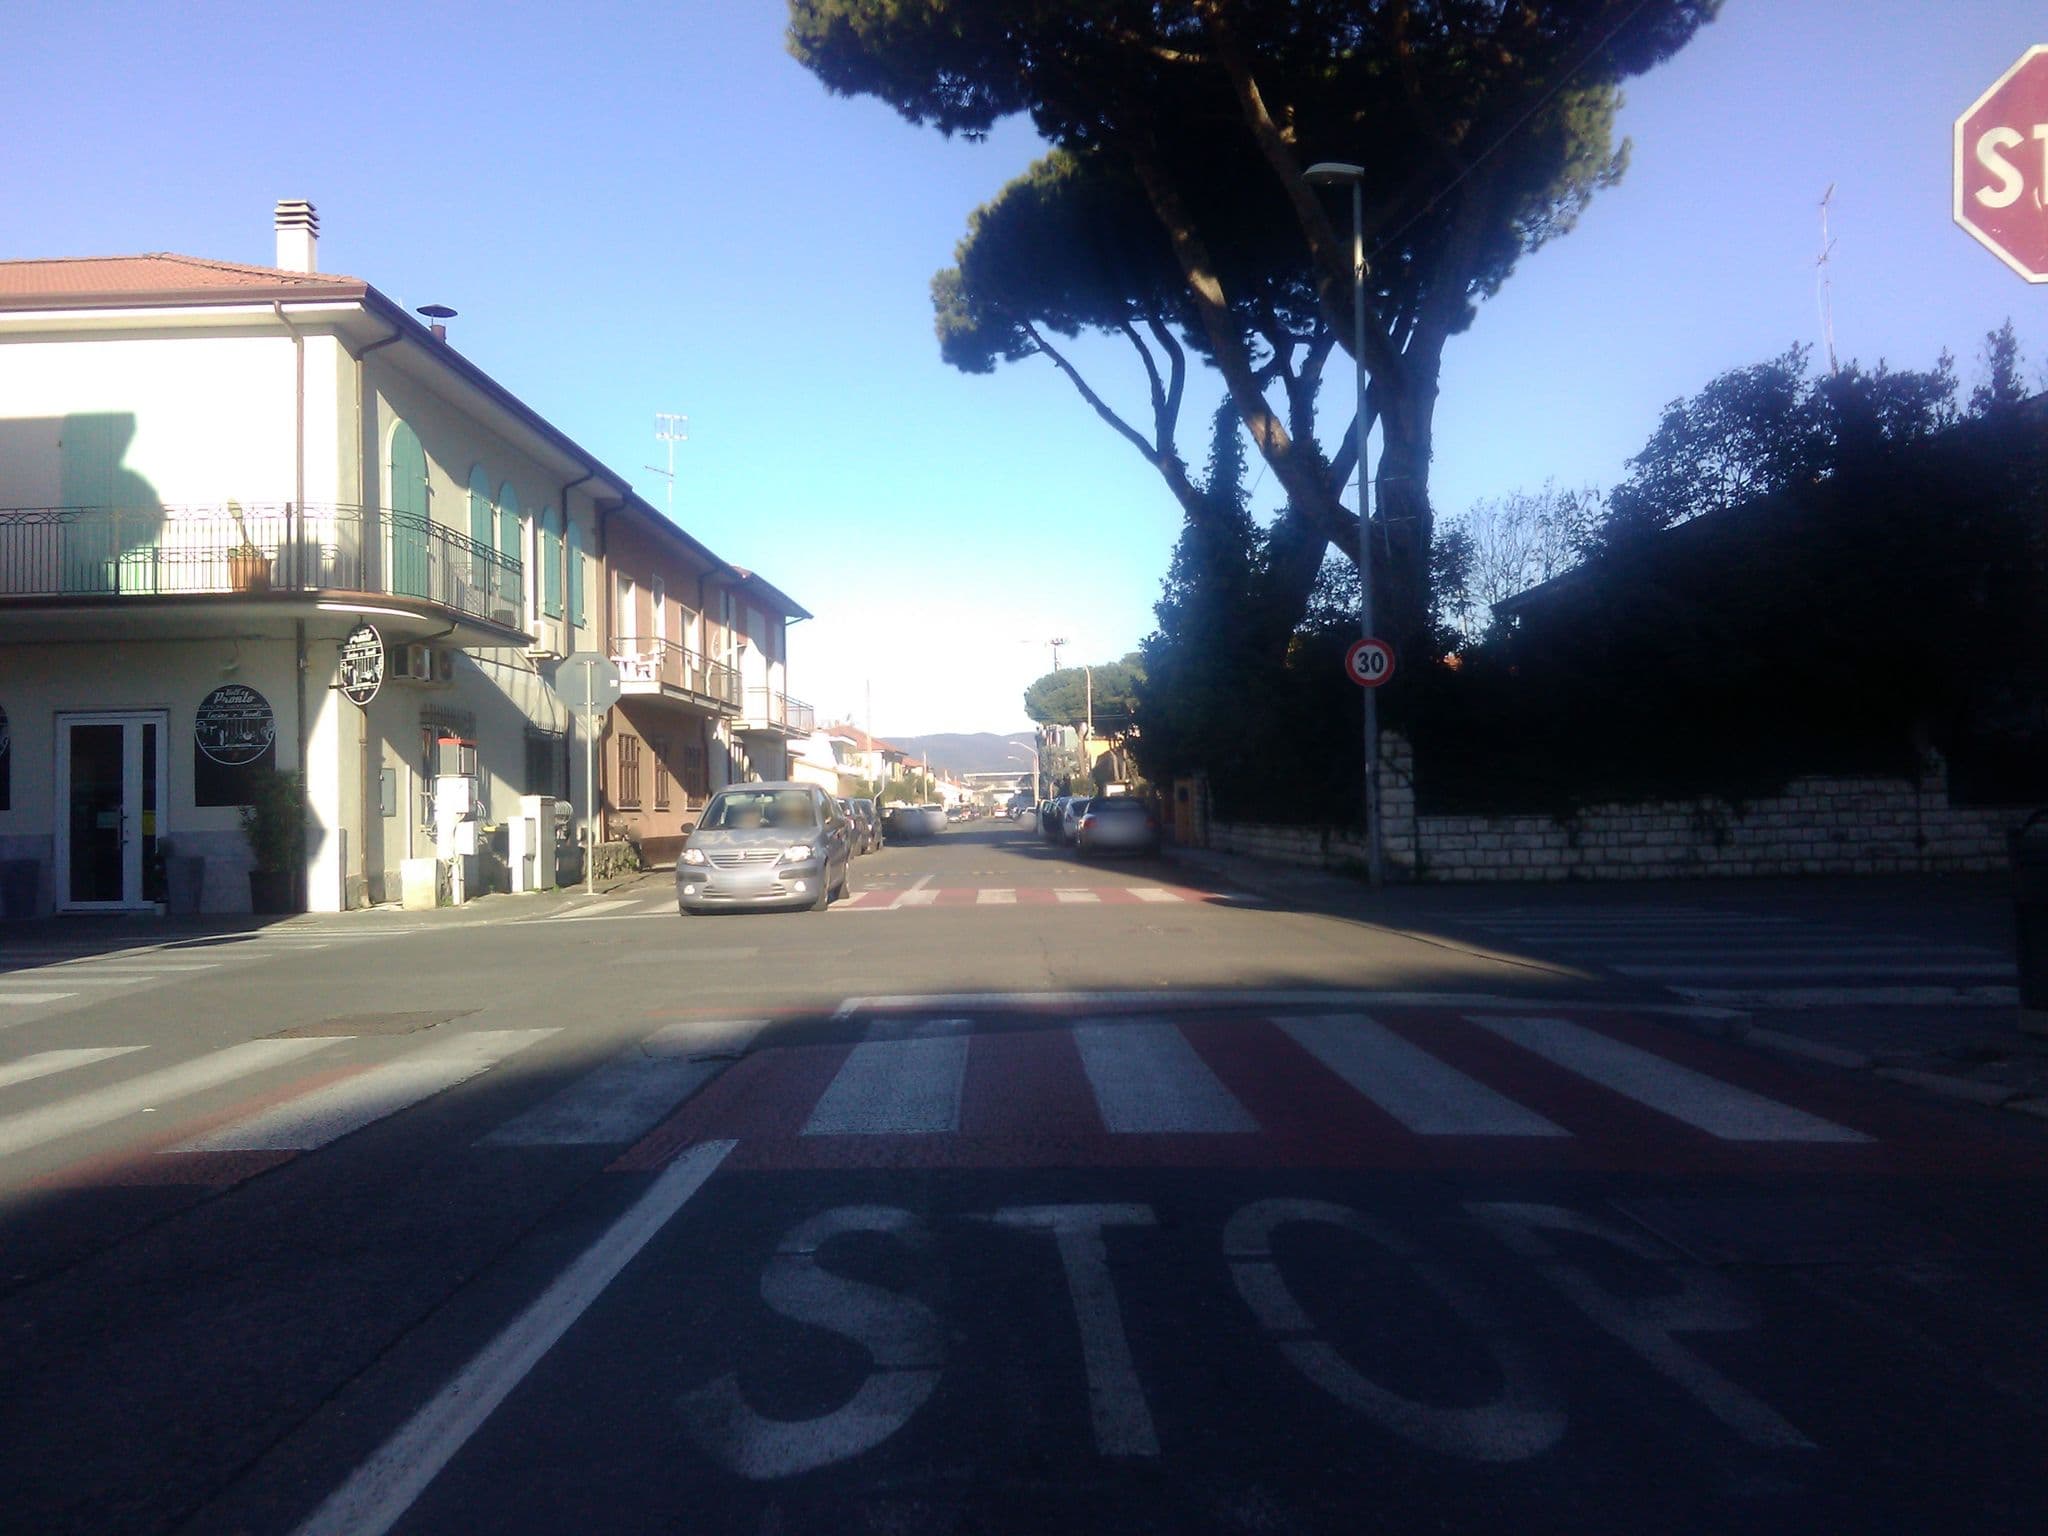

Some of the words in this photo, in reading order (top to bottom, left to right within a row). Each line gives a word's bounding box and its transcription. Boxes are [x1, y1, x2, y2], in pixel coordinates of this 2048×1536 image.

[1358, 651, 1384, 673] 30
[213, 691, 256, 704] Pronto
[673, 1197, 1819, 1480] STOP
